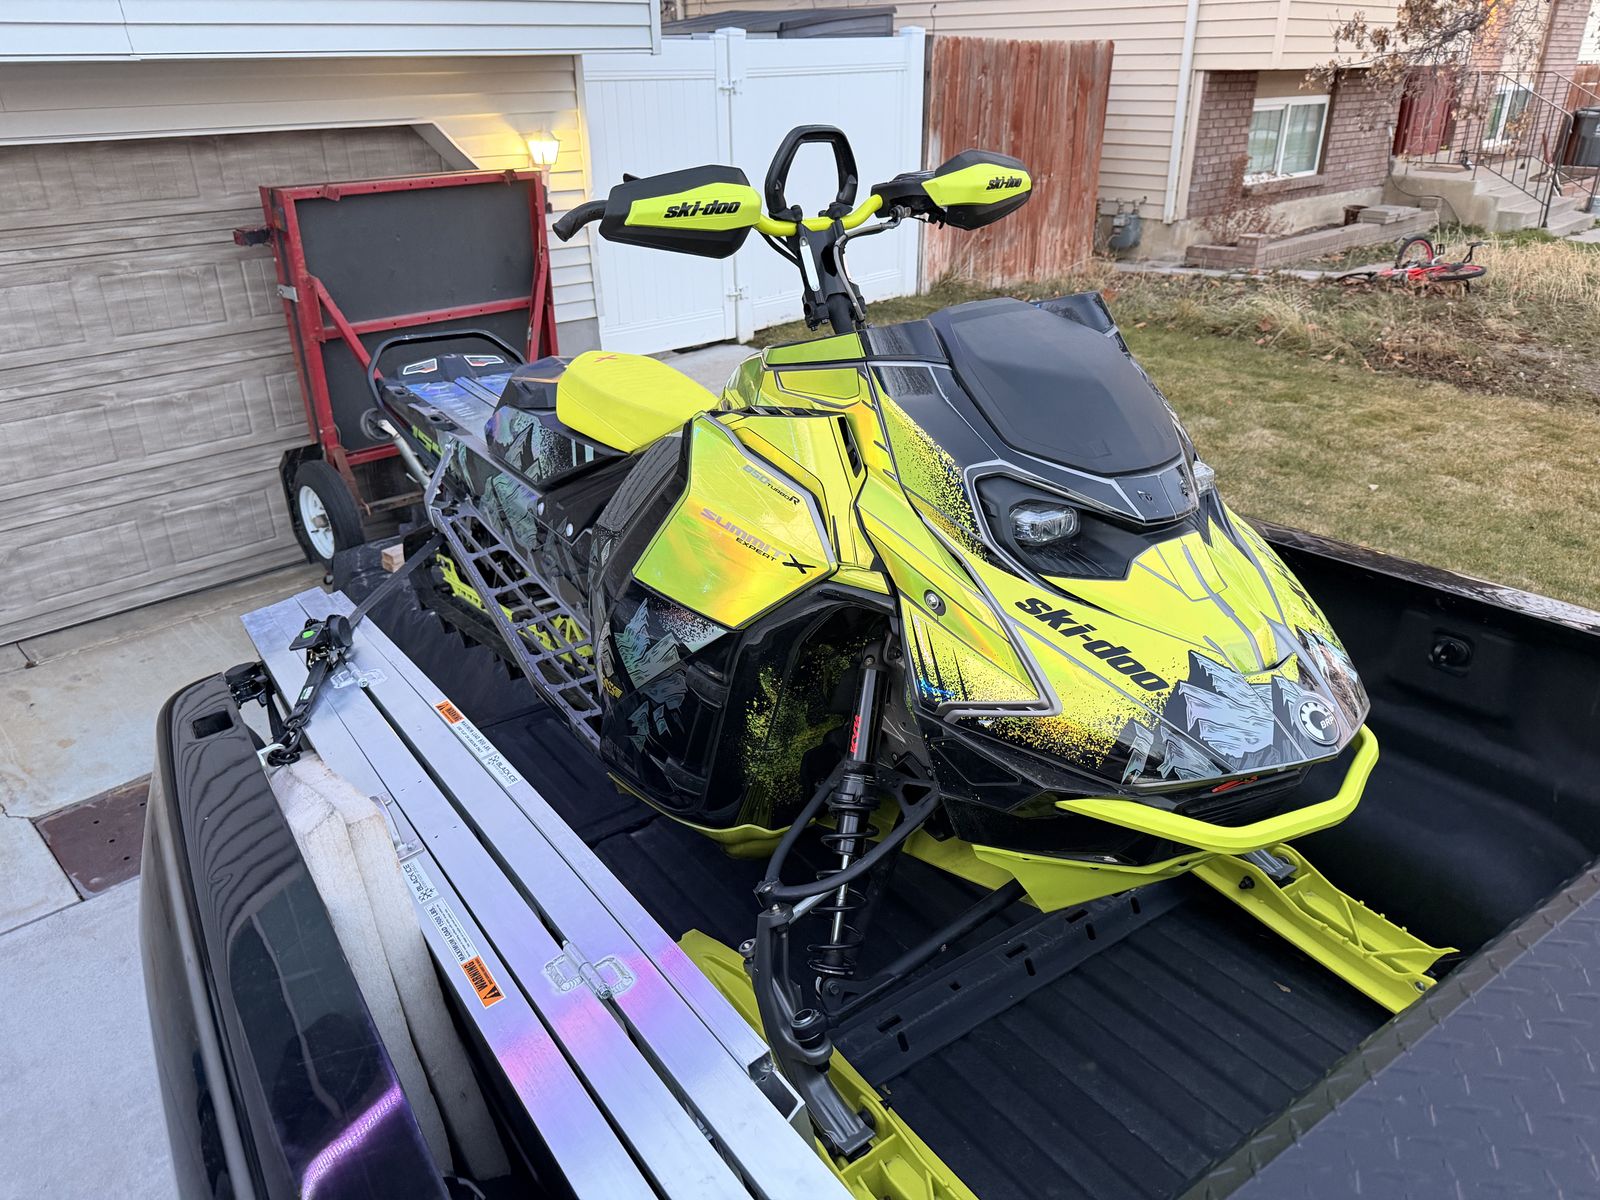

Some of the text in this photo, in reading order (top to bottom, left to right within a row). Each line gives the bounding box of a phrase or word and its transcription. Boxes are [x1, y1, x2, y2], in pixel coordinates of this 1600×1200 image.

[986, 176, 1022, 190] ski-doo
[664, 200, 741, 218] ski-doo
[700, 508, 816, 574] SUMMIT X
[736, 537, 777, 562] EXPERT
[1015, 597, 1170, 692] ski-doo
[1320, 716, 1334, 729] BRP
[402, 863, 412, 873] ICE
[408, 872, 423, 892] BLACK
[440, 926, 452, 939] LOAD
[448, 938, 465, 961] MAXIMUM
[463, 960, 488, 991] WARNING
